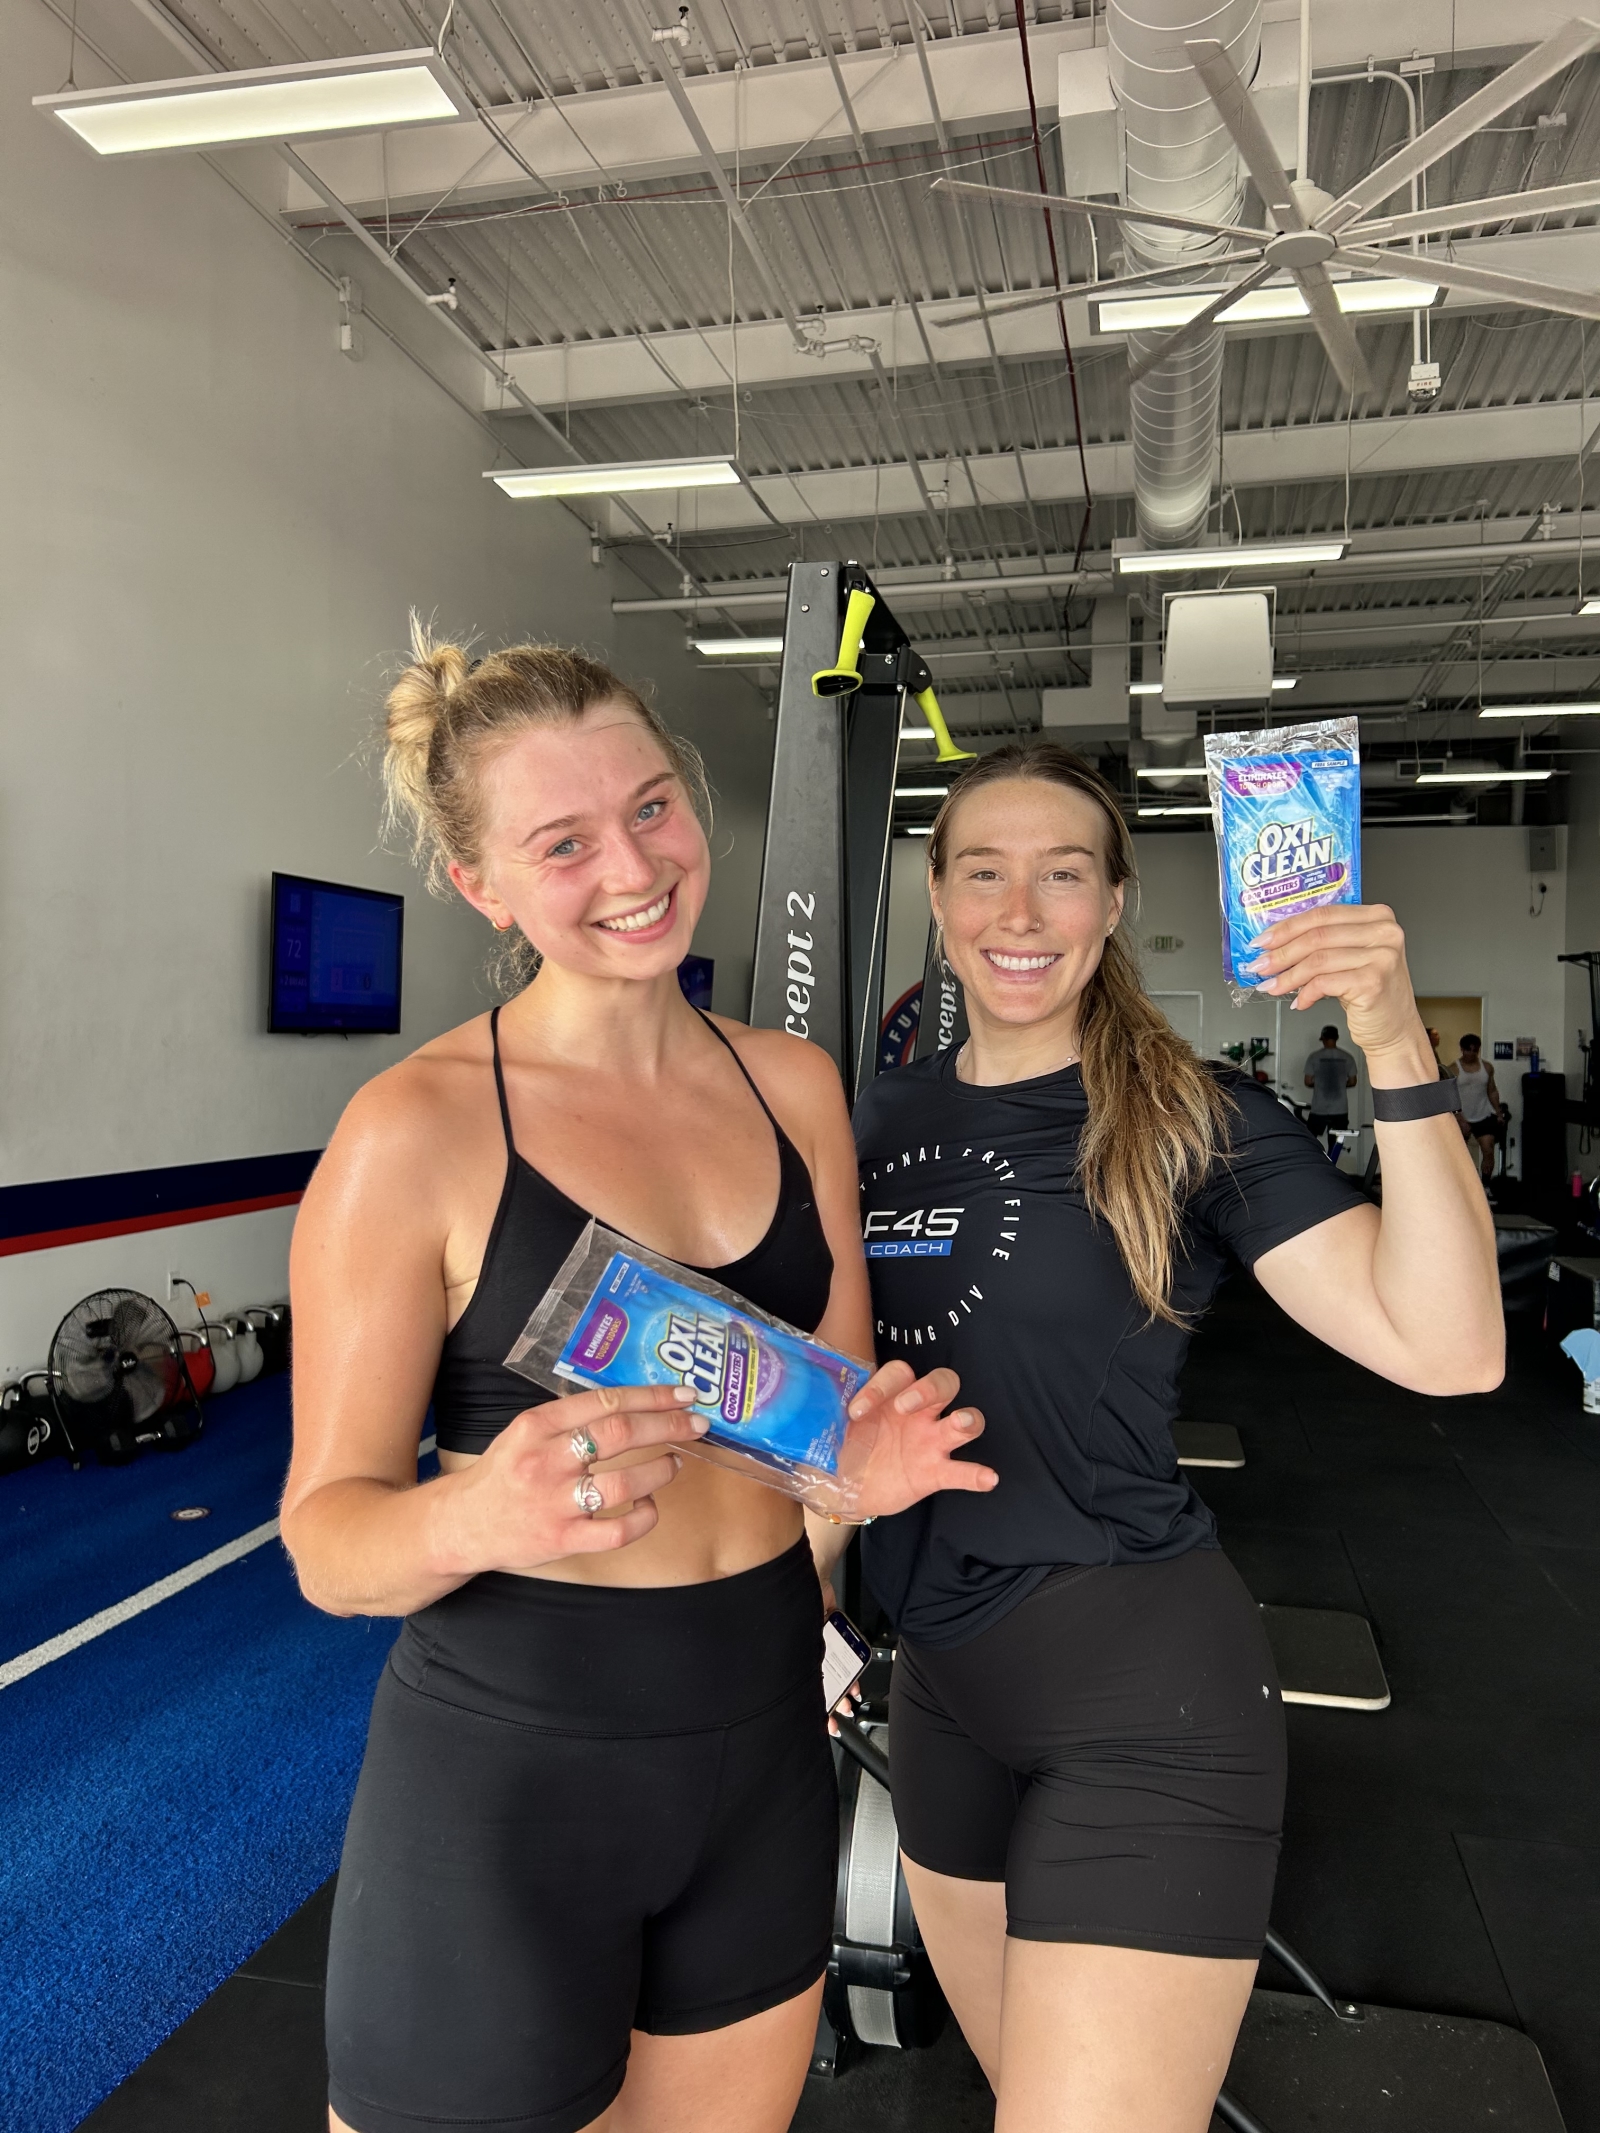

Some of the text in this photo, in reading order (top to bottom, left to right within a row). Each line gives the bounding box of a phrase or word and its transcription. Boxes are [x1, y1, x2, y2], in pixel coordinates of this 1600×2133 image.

[1239, 771, 1288, 782] ELIMINATES
[1259, 820, 1311, 856] OXI
[1242, 838, 1331, 887] CLEAN
[1264, 880, 1298, 896] BLASTERS
[787, 891, 816, 920] 2
[287, 938, 302, 959] 72
[1155, 936, 1173, 949] EXIT
[864, 1208, 965, 1239] F45
[992, 1199, 1021, 1260] FIVE
[870, 1243, 943, 1256] COACH
[584, 1314, 613, 1358] ELIMINATES
[595, 1340, 610, 1360] TOUGH
[660, 1317, 697, 1371] OXI
[684, 1315, 725, 1404] CLEAN
[731, 1353, 741, 1389] BLASTERS
[727, 1392, 738, 1417] ODOR
